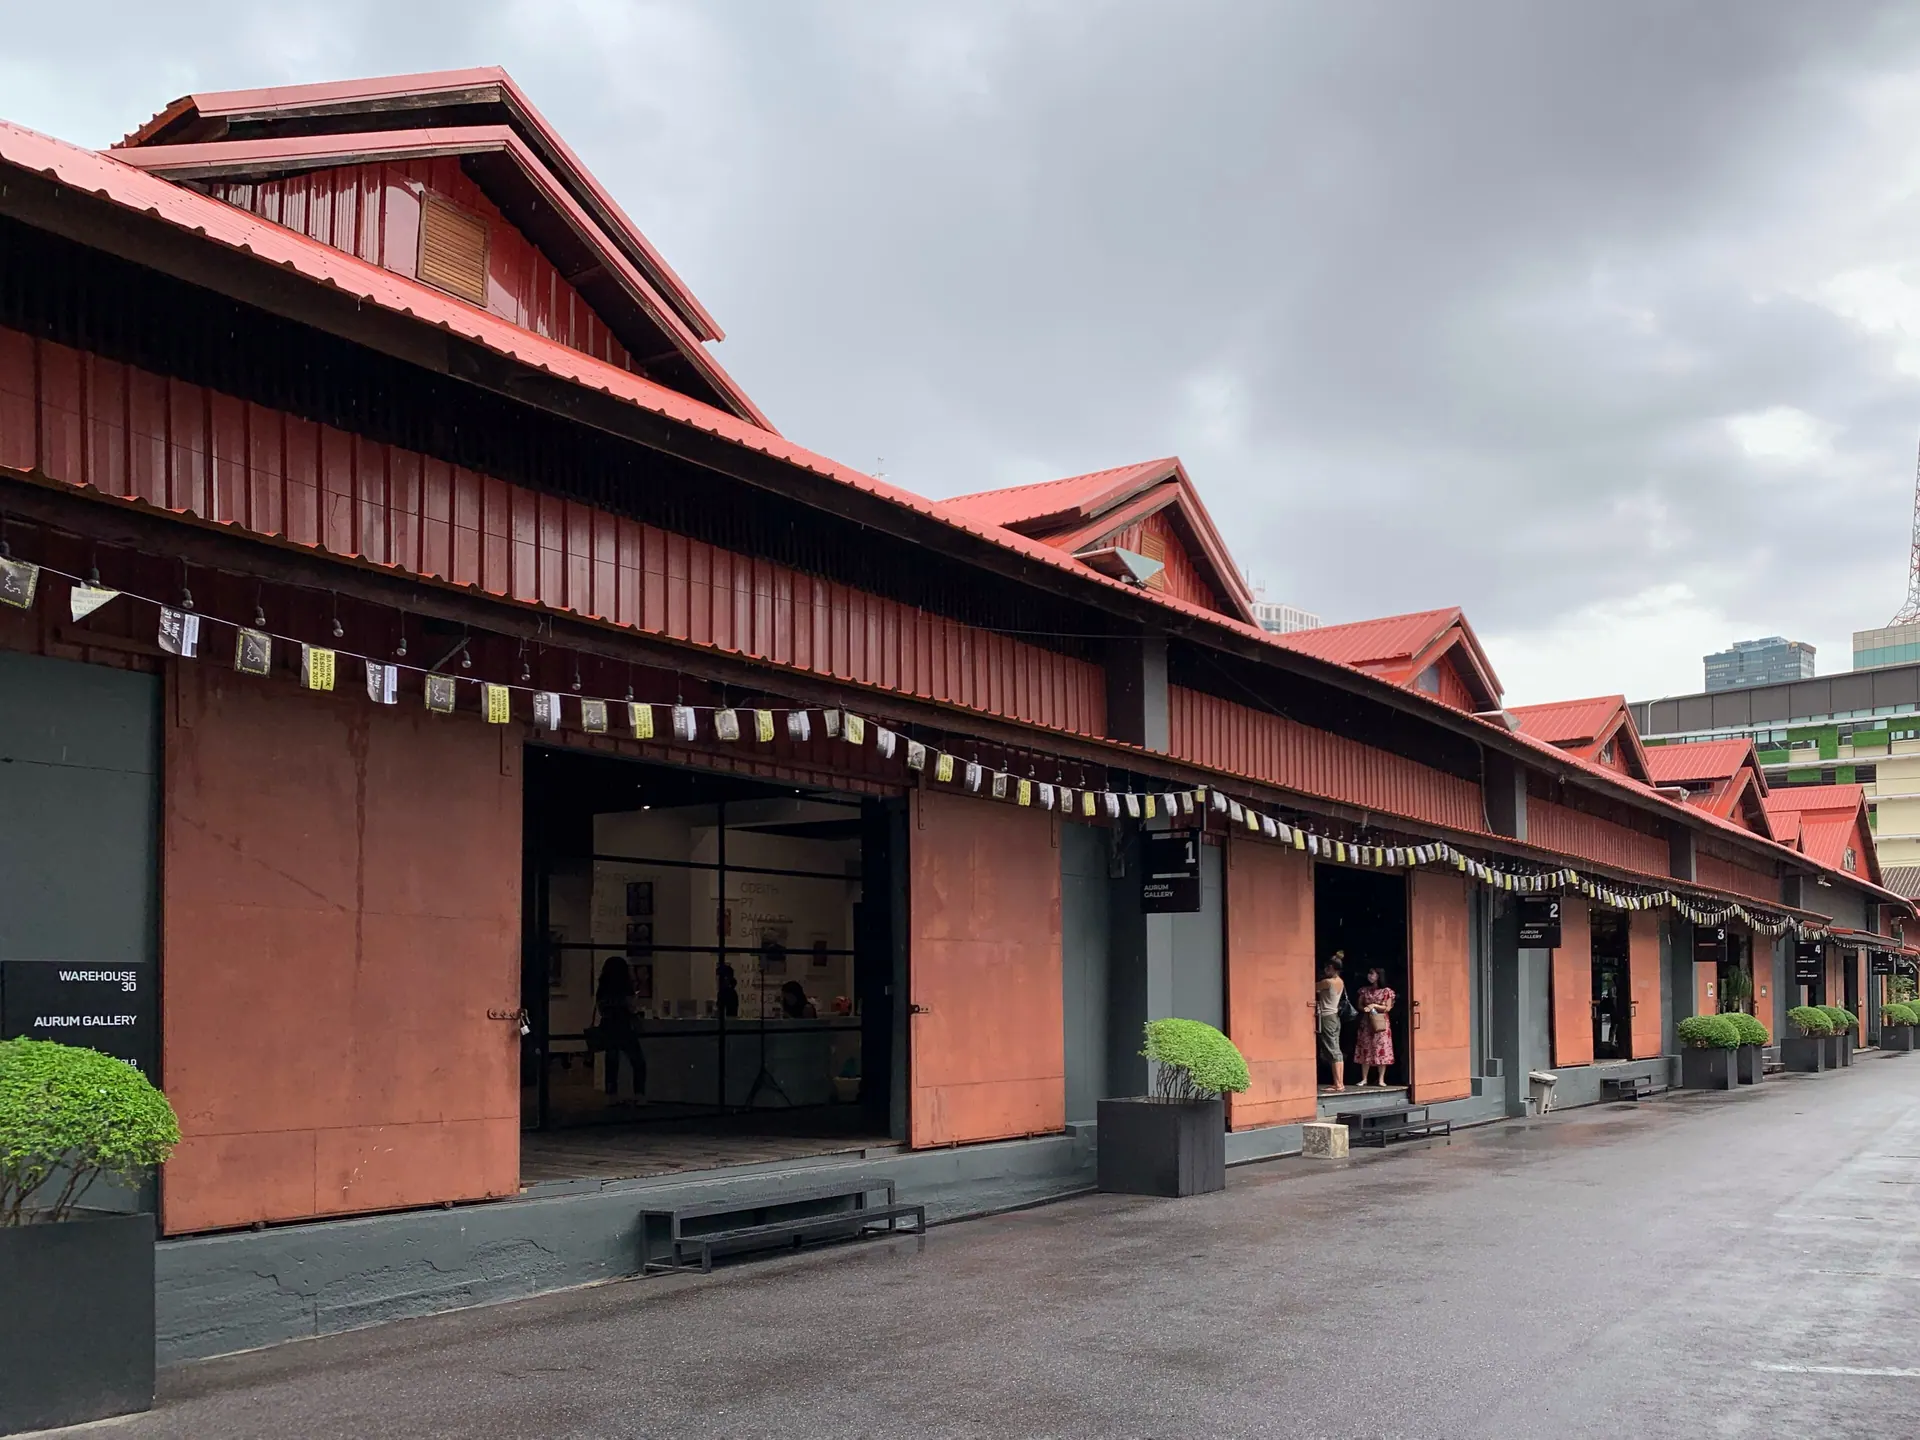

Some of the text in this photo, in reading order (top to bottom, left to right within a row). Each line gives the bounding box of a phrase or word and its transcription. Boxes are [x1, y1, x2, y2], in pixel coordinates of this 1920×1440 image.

[171, 622, 180, 638] May
[1185, 841, 1196, 864] 1
[1550, 903, 1558, 917] 2
[1718, 929, 1724, 940] 3
[1815, 945, 1821, 954] 4
[59, 971, 136, 981] WAREHOUSE
[122, 982, 136, 992] 30
[34, 1015, 137, 1026] AURUM GALLERY
